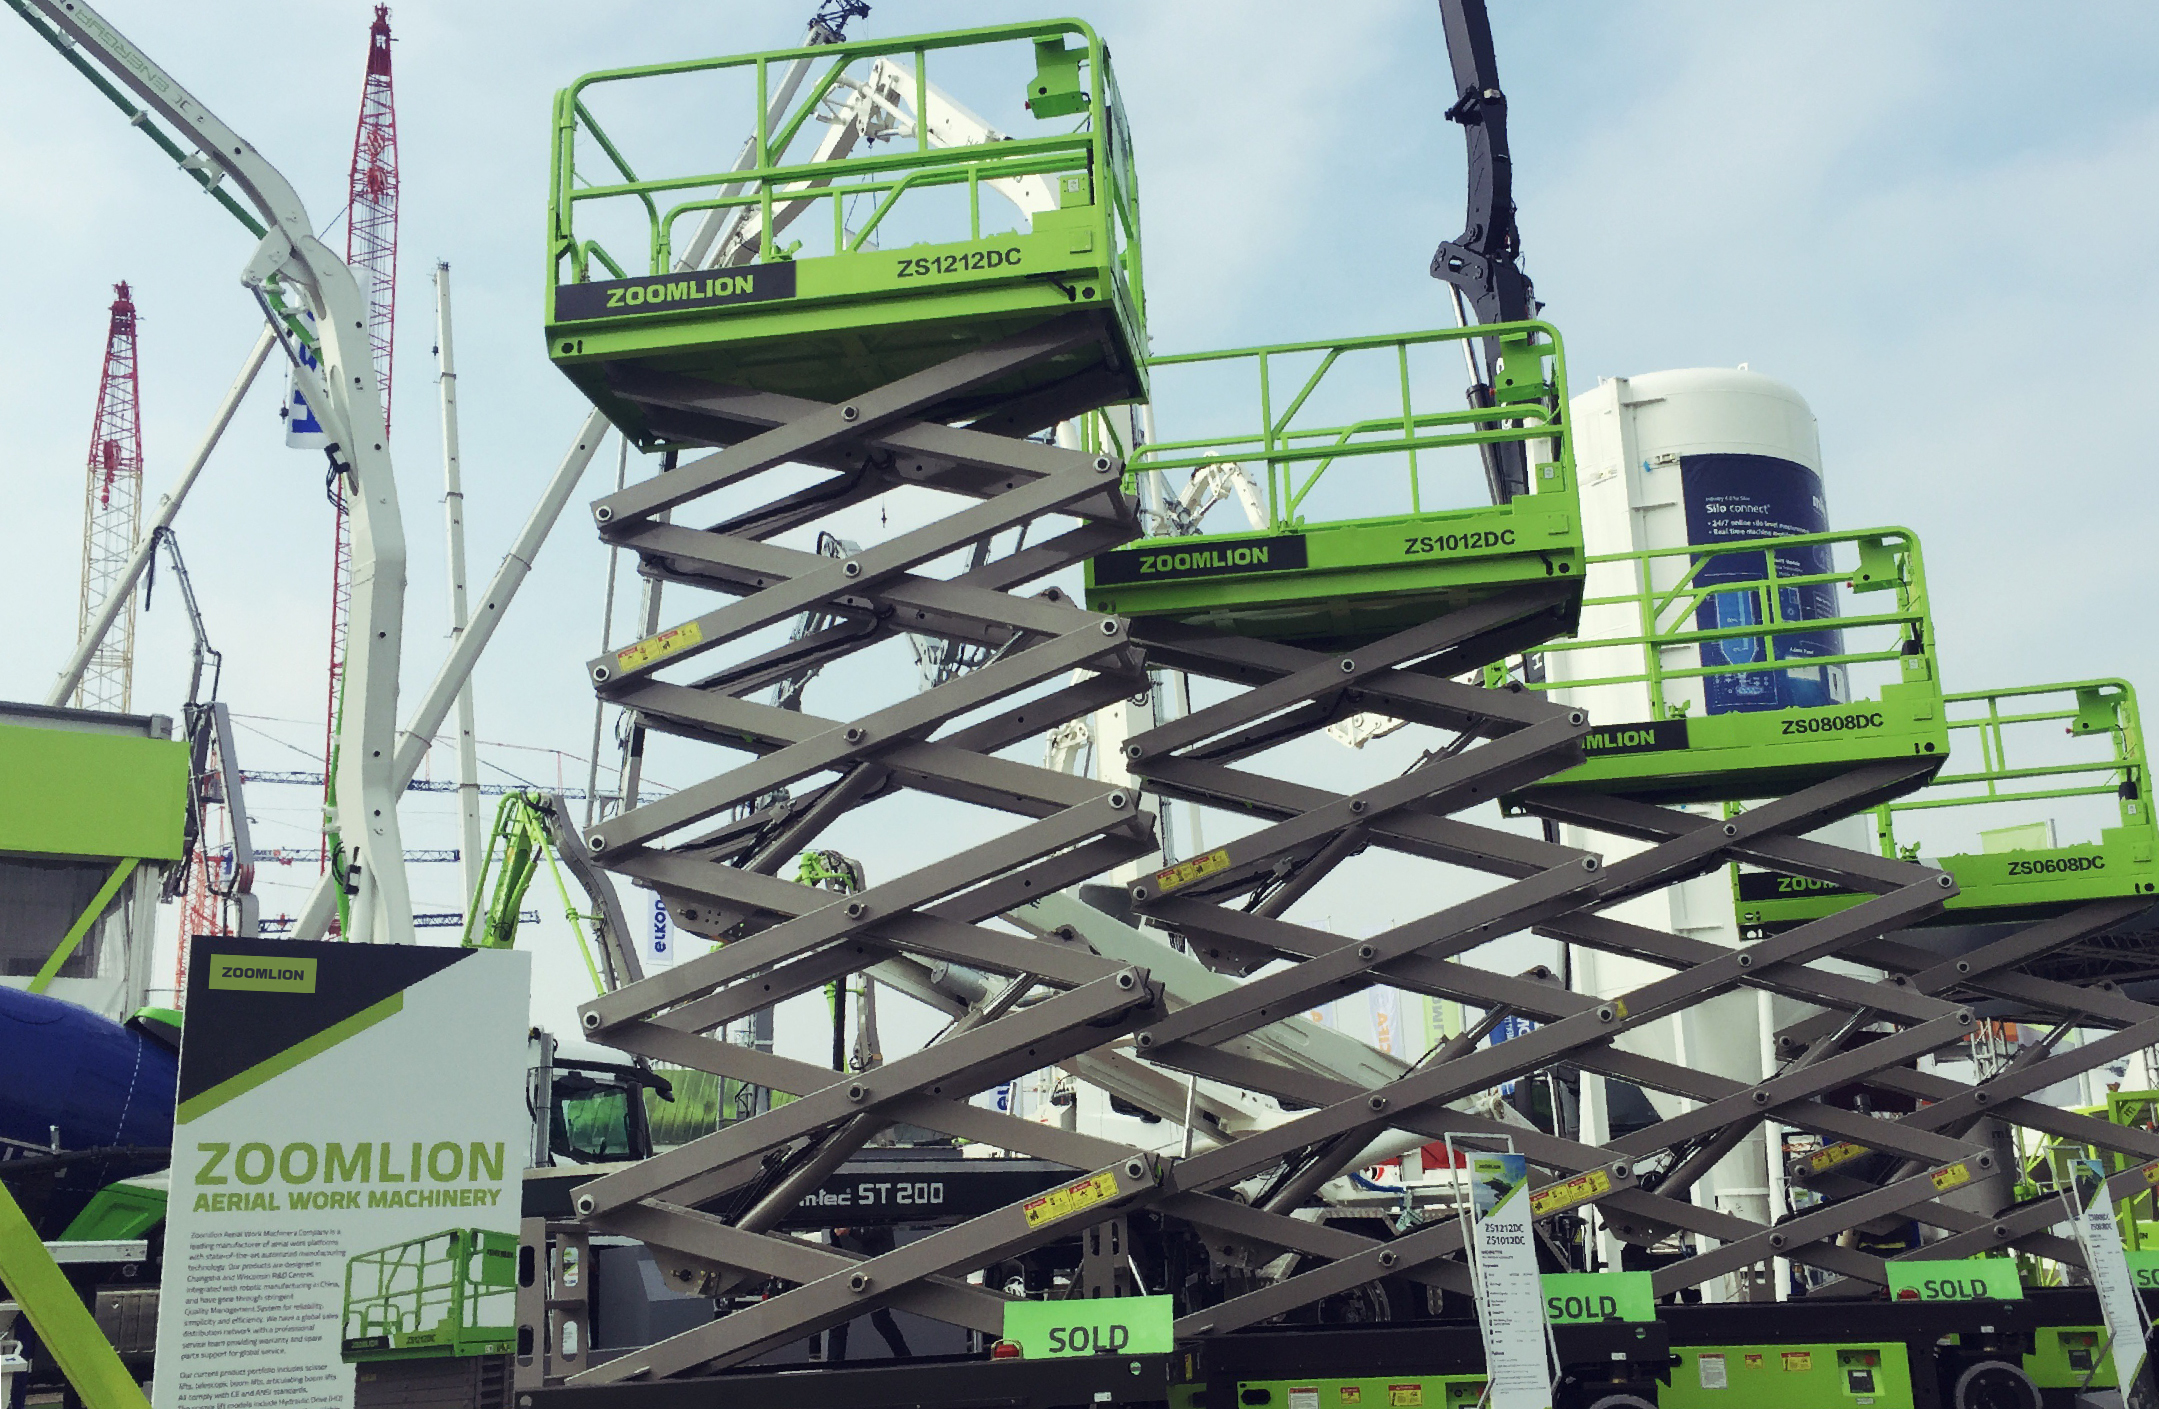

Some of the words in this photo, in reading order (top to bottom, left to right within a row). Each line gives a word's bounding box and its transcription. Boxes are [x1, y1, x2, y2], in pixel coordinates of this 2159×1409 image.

[897, 247, 1023, 278] ZS1212DC
[606, 274, 755, 308] ZOOMLION
[1706, 504, 1726, 514] Silo
[1404, 529, 1516, 555] ZS1012DC
[1140, 546, 1269, 574] ZOOMLION
[1781, 712, 1884, 736] ZS0808DC
[1582, 729, 1655, 749] MLION
[2007, 855, 2105, 877] ZS0608DC
[222, 966, 304, 982] ZOOMLION
[194, 1141, 505, 1186] ZOOMLION
[192, 1192, 281, 1213] AERIAL
[289, 1190, 360, 1211] WORK
[368, 1187, 502, 1210] MACHINERY
[858, 1183, 892, 1205] ST
[896, 1182, 944, 1205] 200
[1924, 1279, 1988, 1299] SOLD
[1547, 1296, 1617, 1319] SOLD
[1049, 1325, 1129, 1353] SOLD
